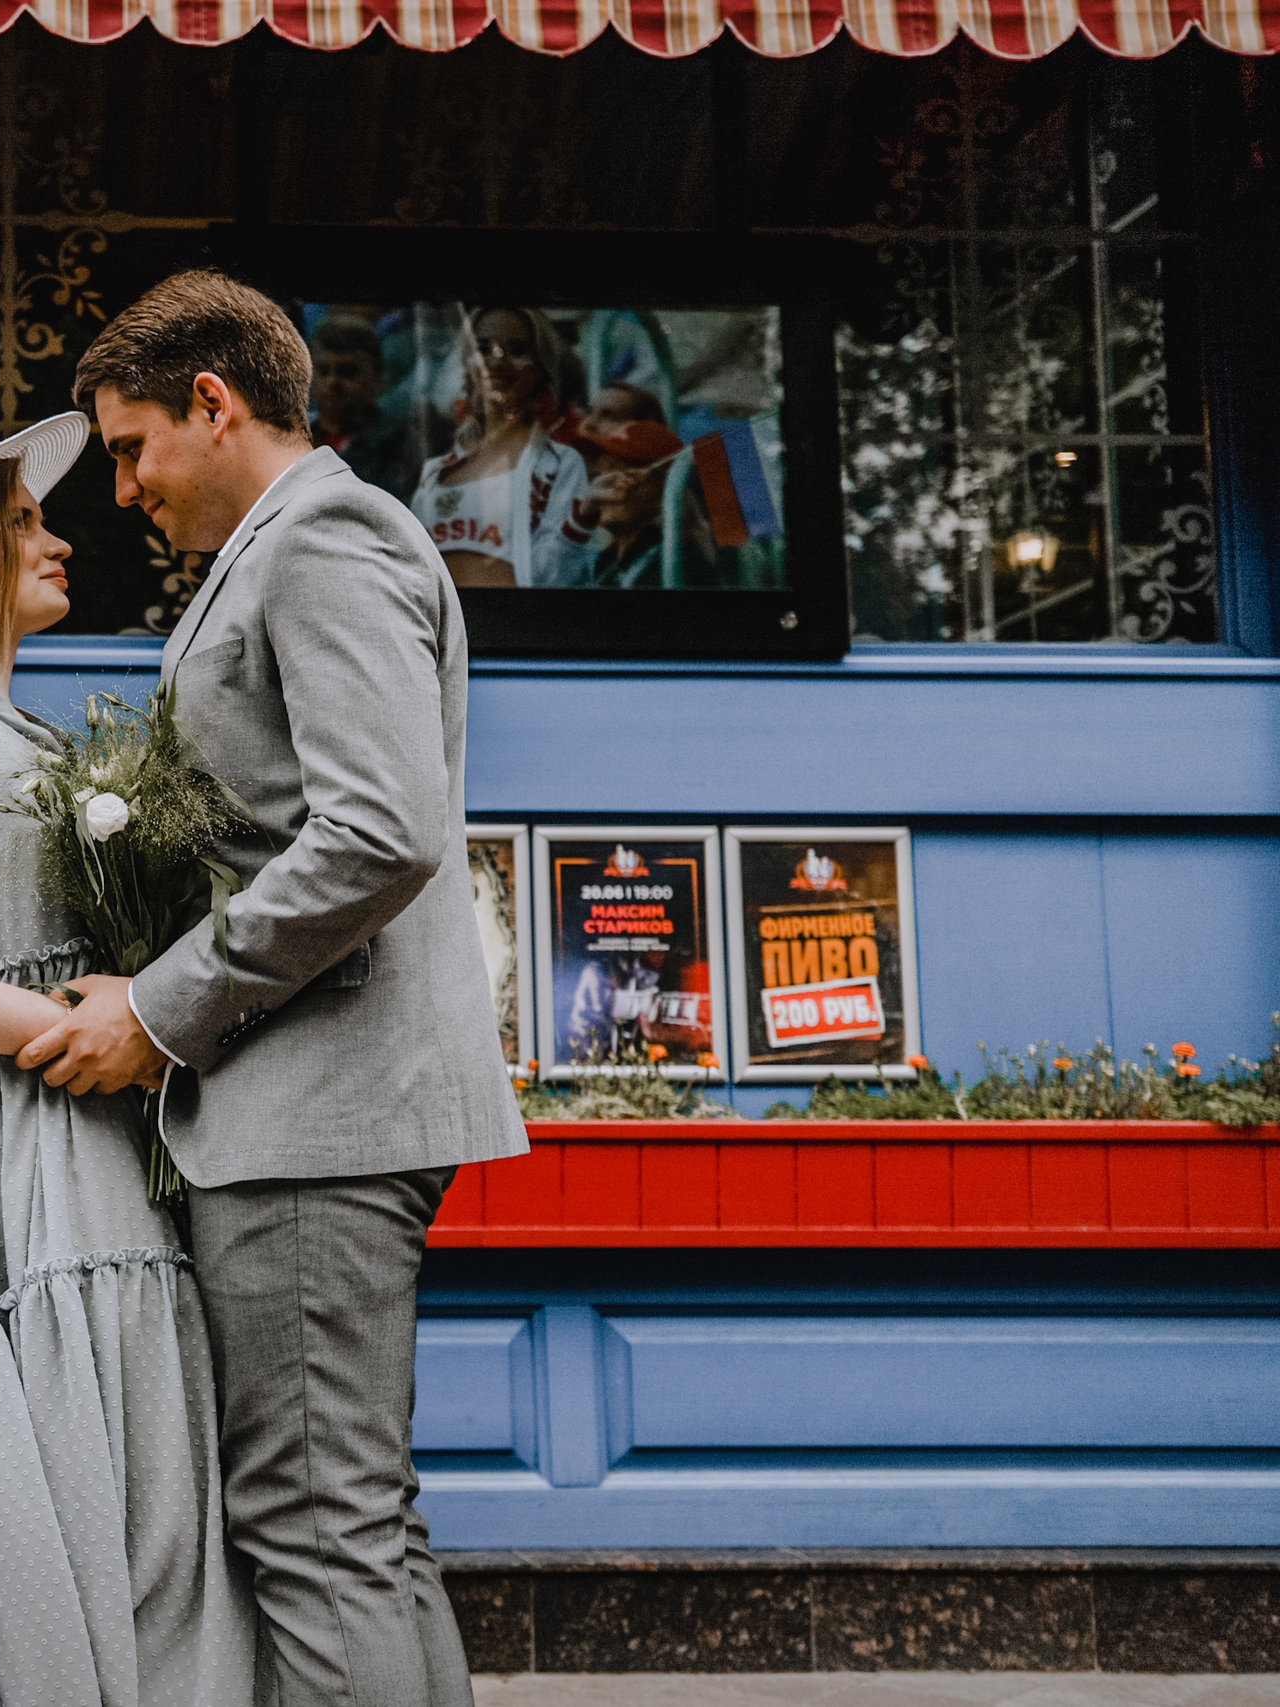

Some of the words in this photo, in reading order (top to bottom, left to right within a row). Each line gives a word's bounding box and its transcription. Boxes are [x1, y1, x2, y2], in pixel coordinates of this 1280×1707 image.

[426, 517, 503, 548] SSIA
[590, 904, 665, 919] МАКСИМ
[759, 912, 876, 940] ФИРМЕННОЕ
[583, 919, 674, 935] СТАРИКОВ
[762, 936, 880, 989] ПИВО
[773, 998, 820, 1029] 200
[822, 995, 880, 1026] РУБ.
